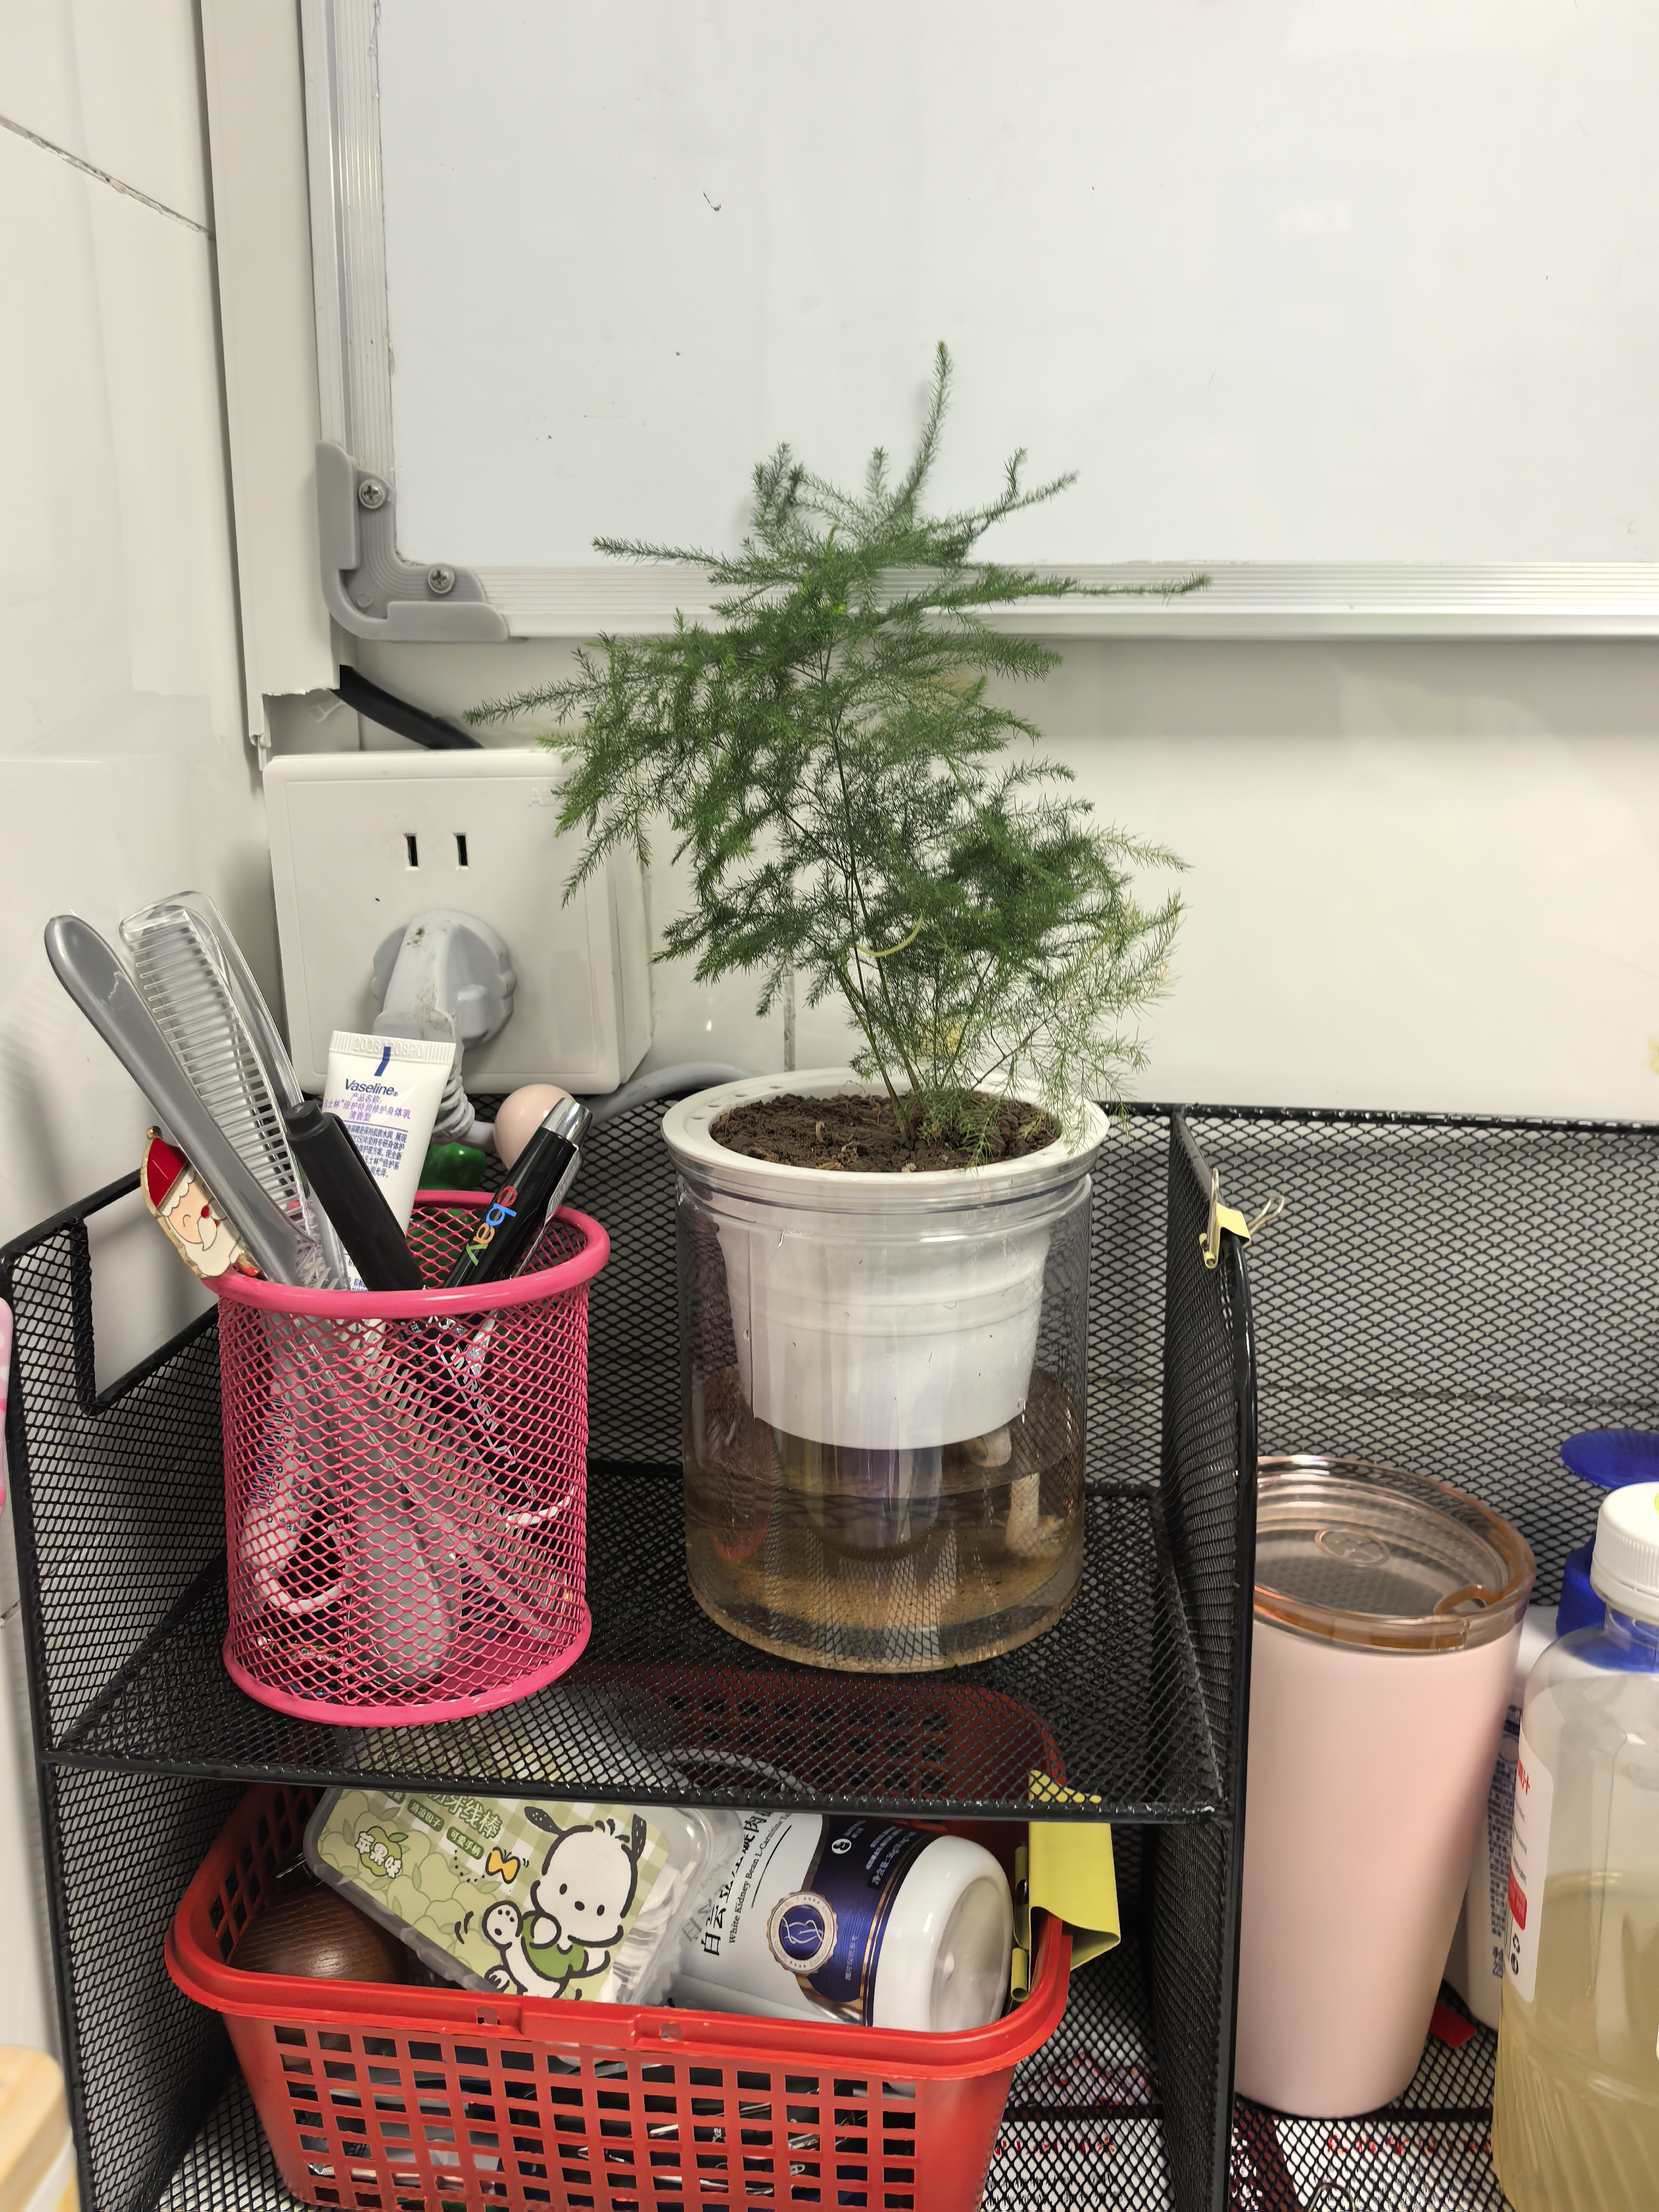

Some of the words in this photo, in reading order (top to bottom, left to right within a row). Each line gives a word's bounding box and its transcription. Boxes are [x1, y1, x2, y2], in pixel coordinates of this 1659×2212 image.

[466, 1185, 517, 1266] ebay
[354, 1831, 403, 1879] 苹果味
[449, 1829, 482, 1858] 可爱手柄
[745, 1858, 759, 1879] Bean
[734, 1880, 751, 1914] Kidney
[729, 1915, 740, 1944] White
